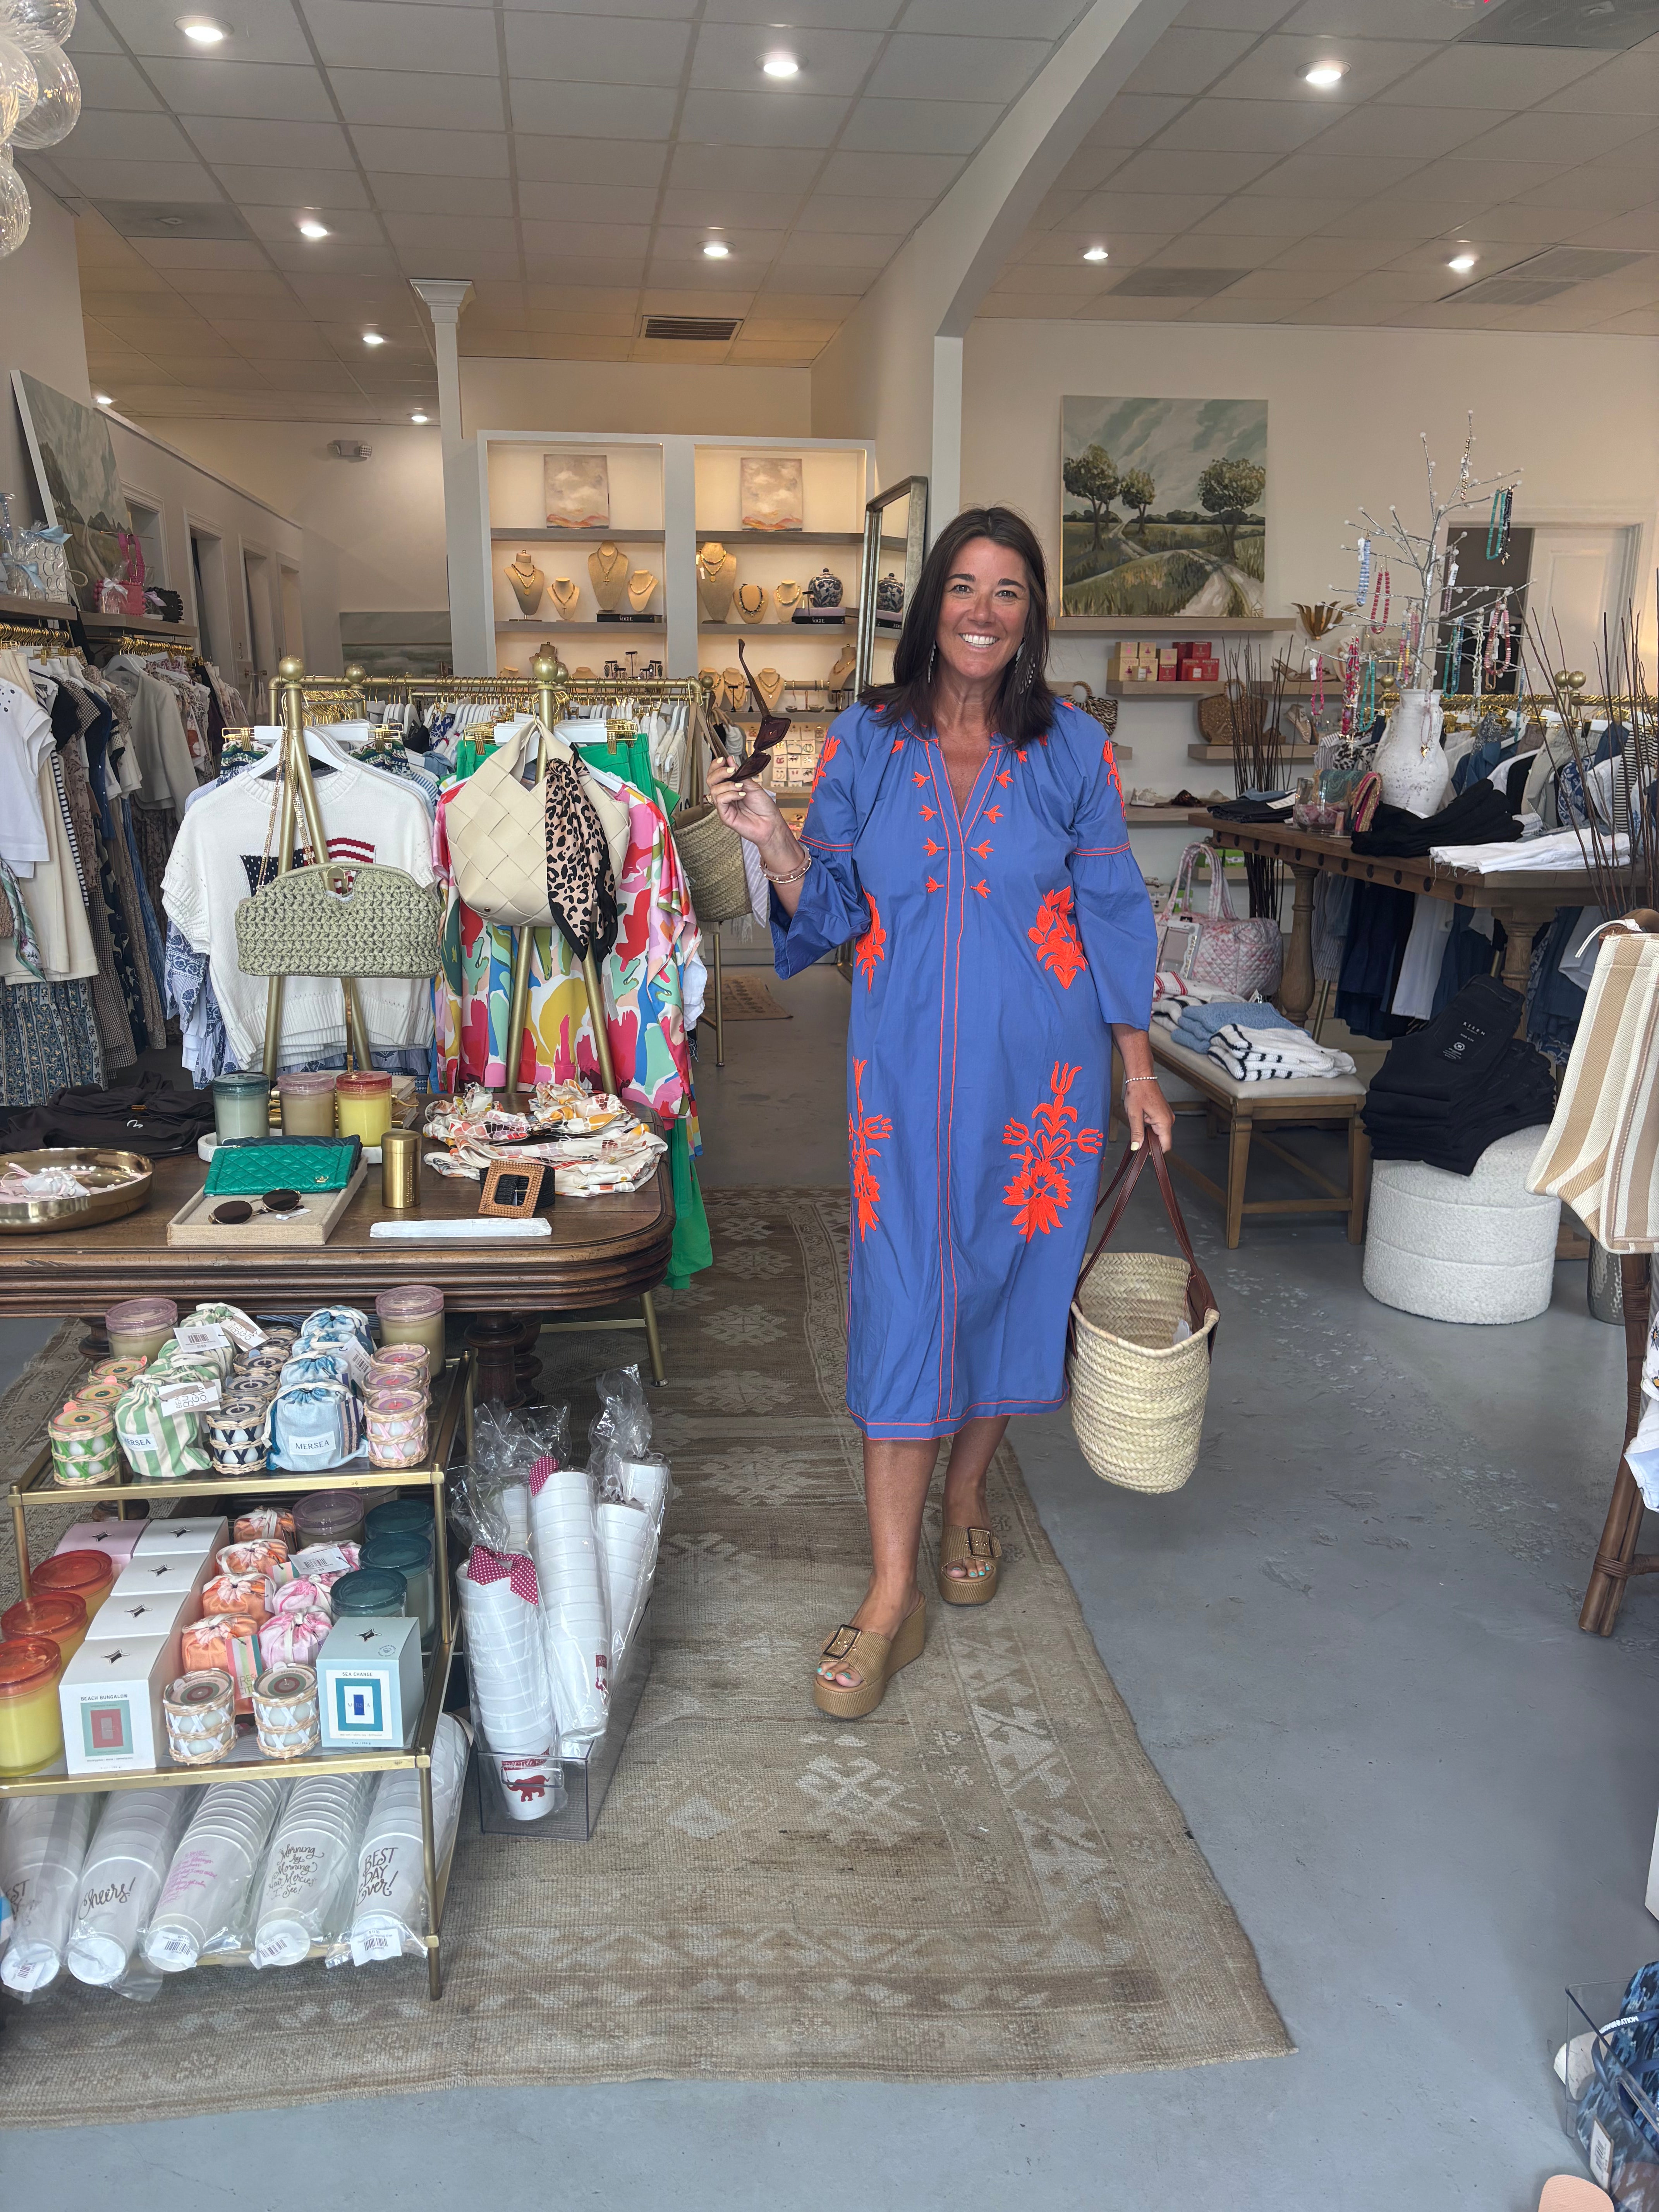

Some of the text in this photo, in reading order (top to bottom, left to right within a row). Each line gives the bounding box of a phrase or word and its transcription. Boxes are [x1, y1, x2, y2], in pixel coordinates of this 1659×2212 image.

[1463, 1022, 1486, 1036] RISEN
[125, 1438, 151, 1446] ERSEA
[295, 1440, 330, 1450] MERSEA
[276, 1844, 325, 1866] Morning
[289, 1853, 305, 1864] by
[362, 1847, 399, 1877] BEST
[273, 1862, 318, 1879] Morning
[281, 1871, 315, 1887] Mercies
[363, 1865, 388, 1887] DAY
[5, 1879, 30, 1903] EST
[356, 1870, 399, 1907] Ever!
[78, 1877, 136, 1920] Cheers!
